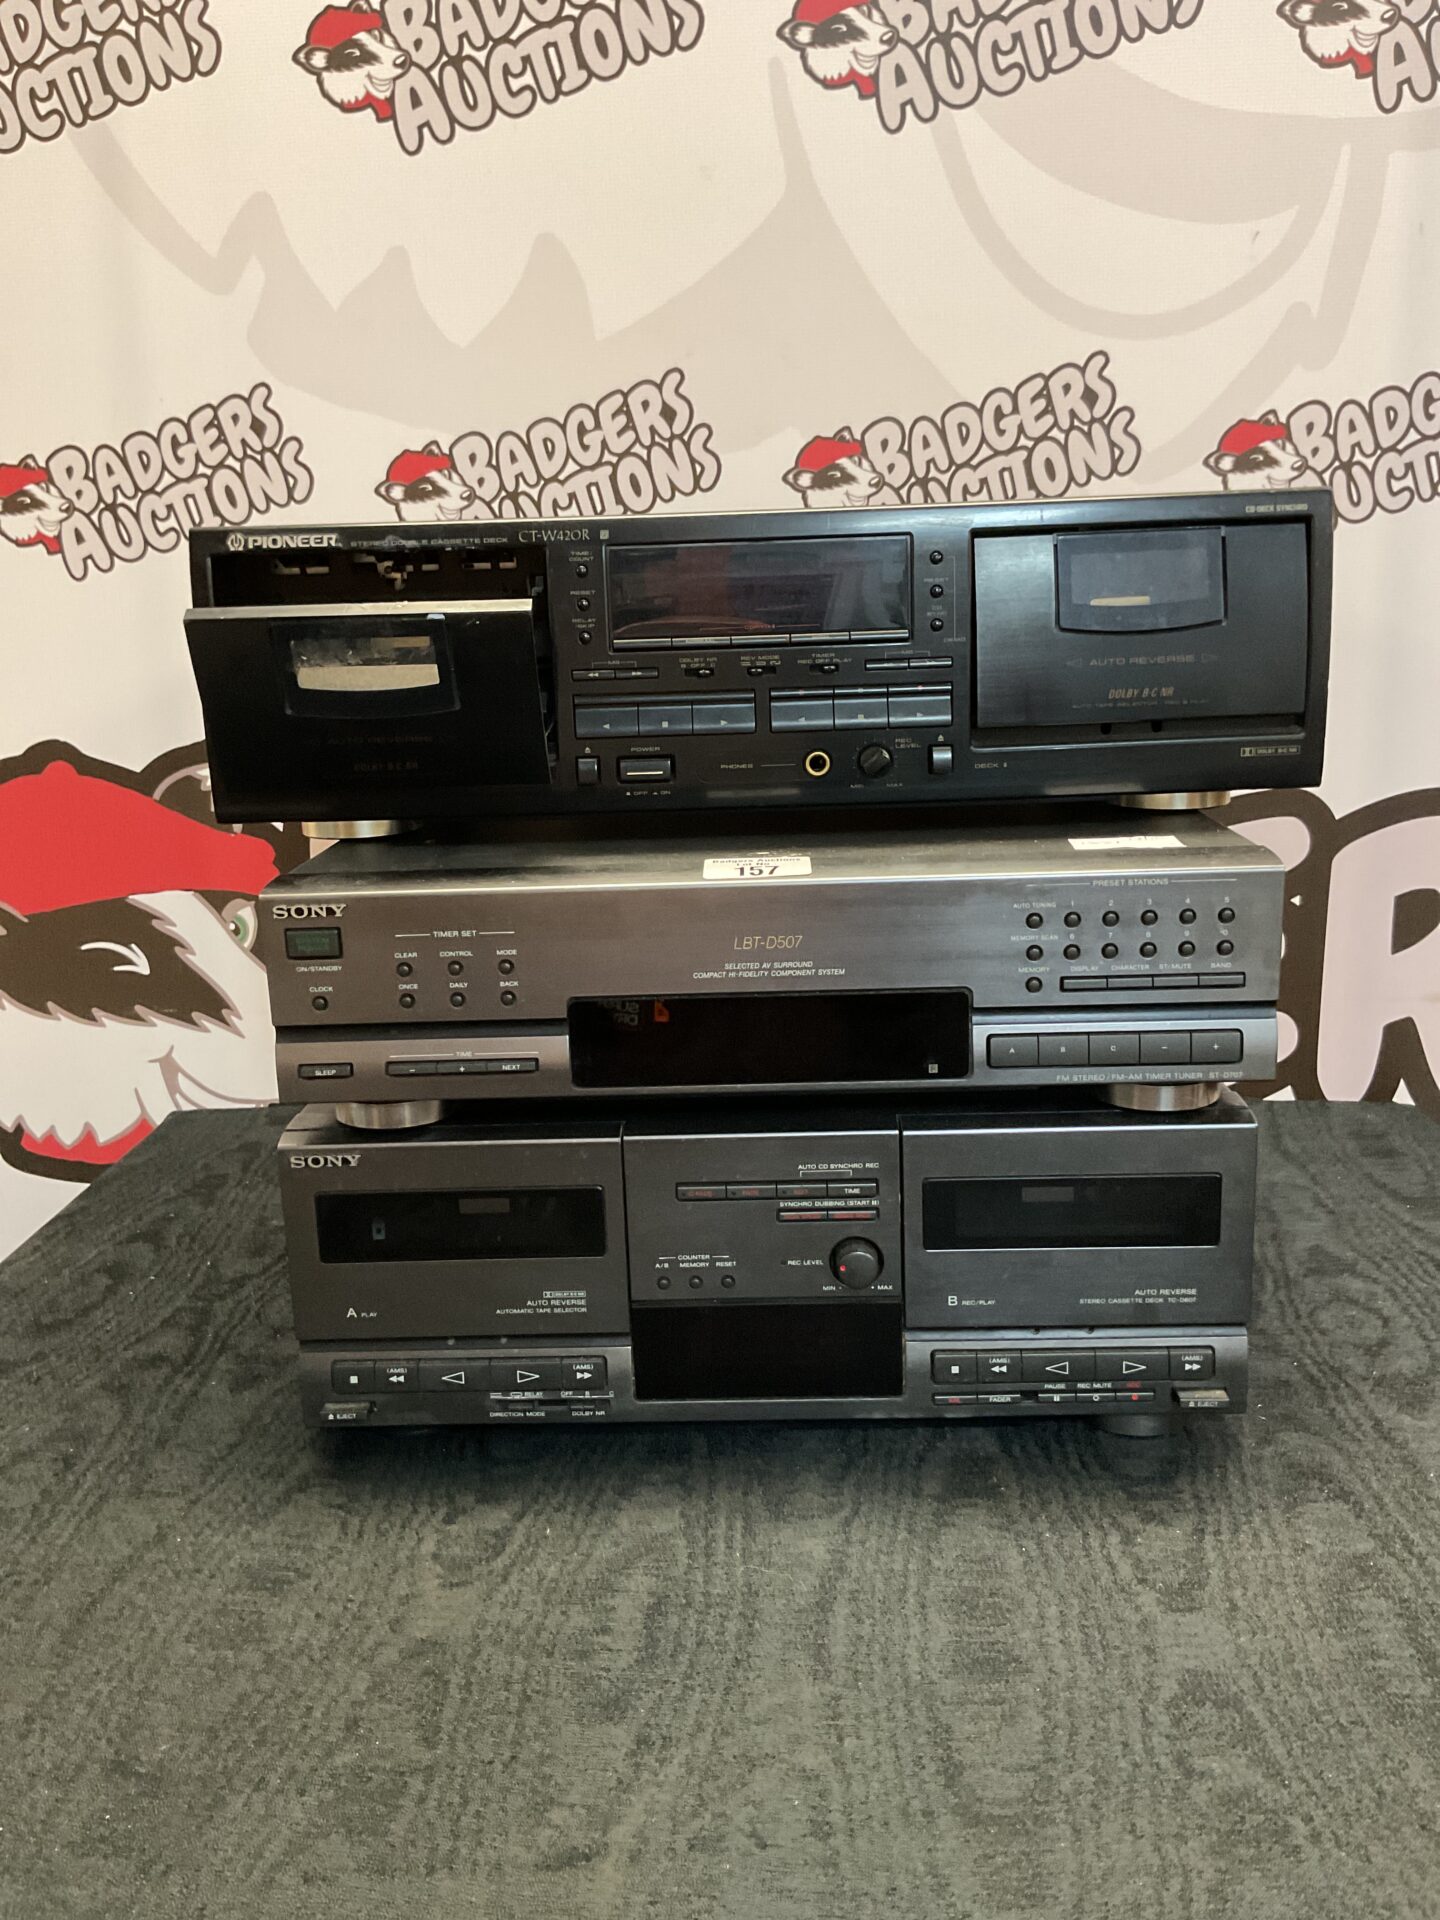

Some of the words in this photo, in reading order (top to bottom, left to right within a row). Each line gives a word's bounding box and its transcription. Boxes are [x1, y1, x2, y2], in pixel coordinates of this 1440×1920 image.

[861, 350, 1117, 489] BADGERS
[450, 367, 694, 502] BADGERS
[46, 382, 283, 515] BADGERS
[60, 436, 314, 581] AUCTIONS
[248, 533, 340, 549] PIONEER
[1089, 656, 1126, 667] AUTO
[1129, 654, 1196, 665] REVERSE
[1108, 688, 1139, 699] DOLBY
[734, 865, 779, 877] 157
[1092, 879, 1126, 887] PRESET
[1127, 878, 1169, 886] STATIONS
[272, 904, 347, 919] SONY
[433, 930, 459, 938] TIMER
[461, 929, 477, 937] SET
[733, 935, 803, 950] LBT-D507
[439, 950, 474, 958] CONTROL
[295, 965, 343, 973] ON/STANDBY
[724, 962, 761, 970] SELECTED
[773, 960, 814, 969] SURROUND
[1110, 963, 1150, 971] CHARACTER
[692, 971, 726, 979] COMPACT
[728, 970, 769, 978] HI-FIDELITY
[770, 969, 816, 977] COMPONENT
[817, 968, 846, 976] SYSTEM
[315, 1069, 337, 1077] SLEEP
[1144, 1072, 1172, 1080] TIMER
[290, 1154, 361, 1169] SONY
[947, 1295, 958, 1306] B
[346, 1307, 358, 1318] A
